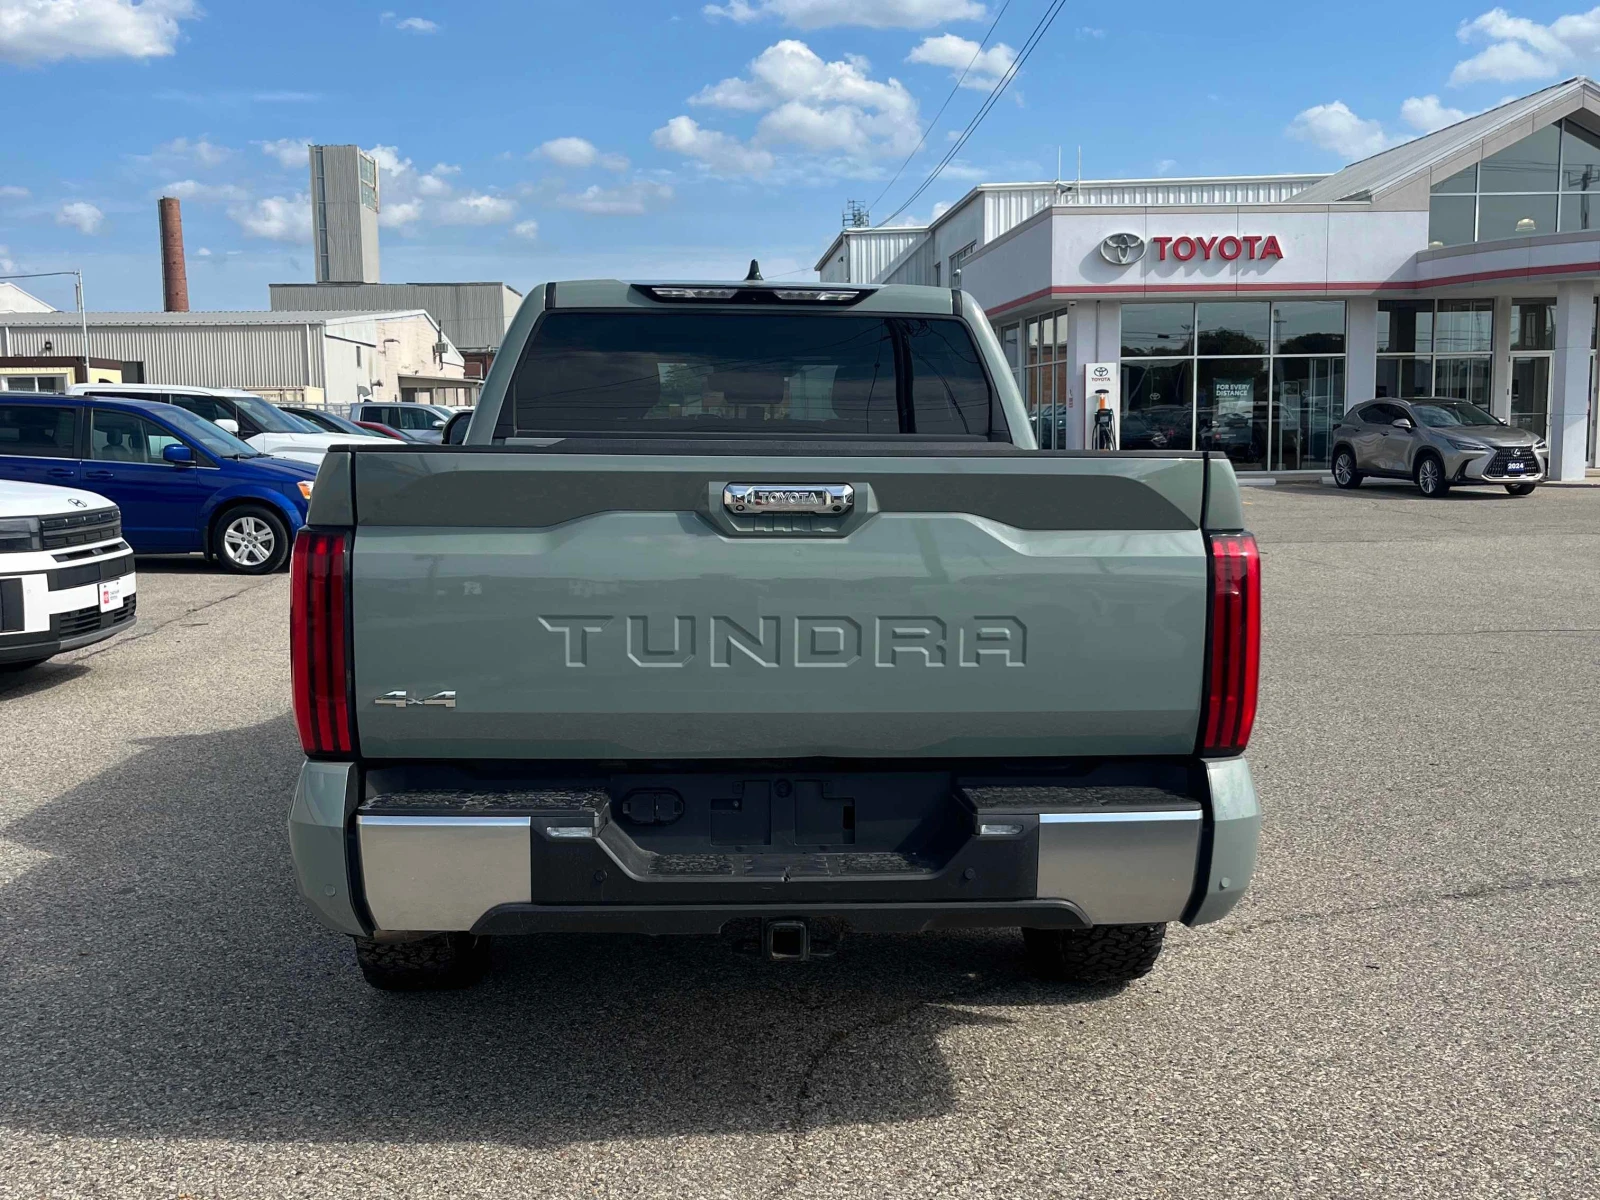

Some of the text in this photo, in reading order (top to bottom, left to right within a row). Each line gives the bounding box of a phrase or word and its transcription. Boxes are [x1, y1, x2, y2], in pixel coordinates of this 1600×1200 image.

[1152, 235, 1284, 261] TOYOTA
[758, 491, 818, 504] TOYOTA
[537, 615, 1028, 668] TUNDRA
